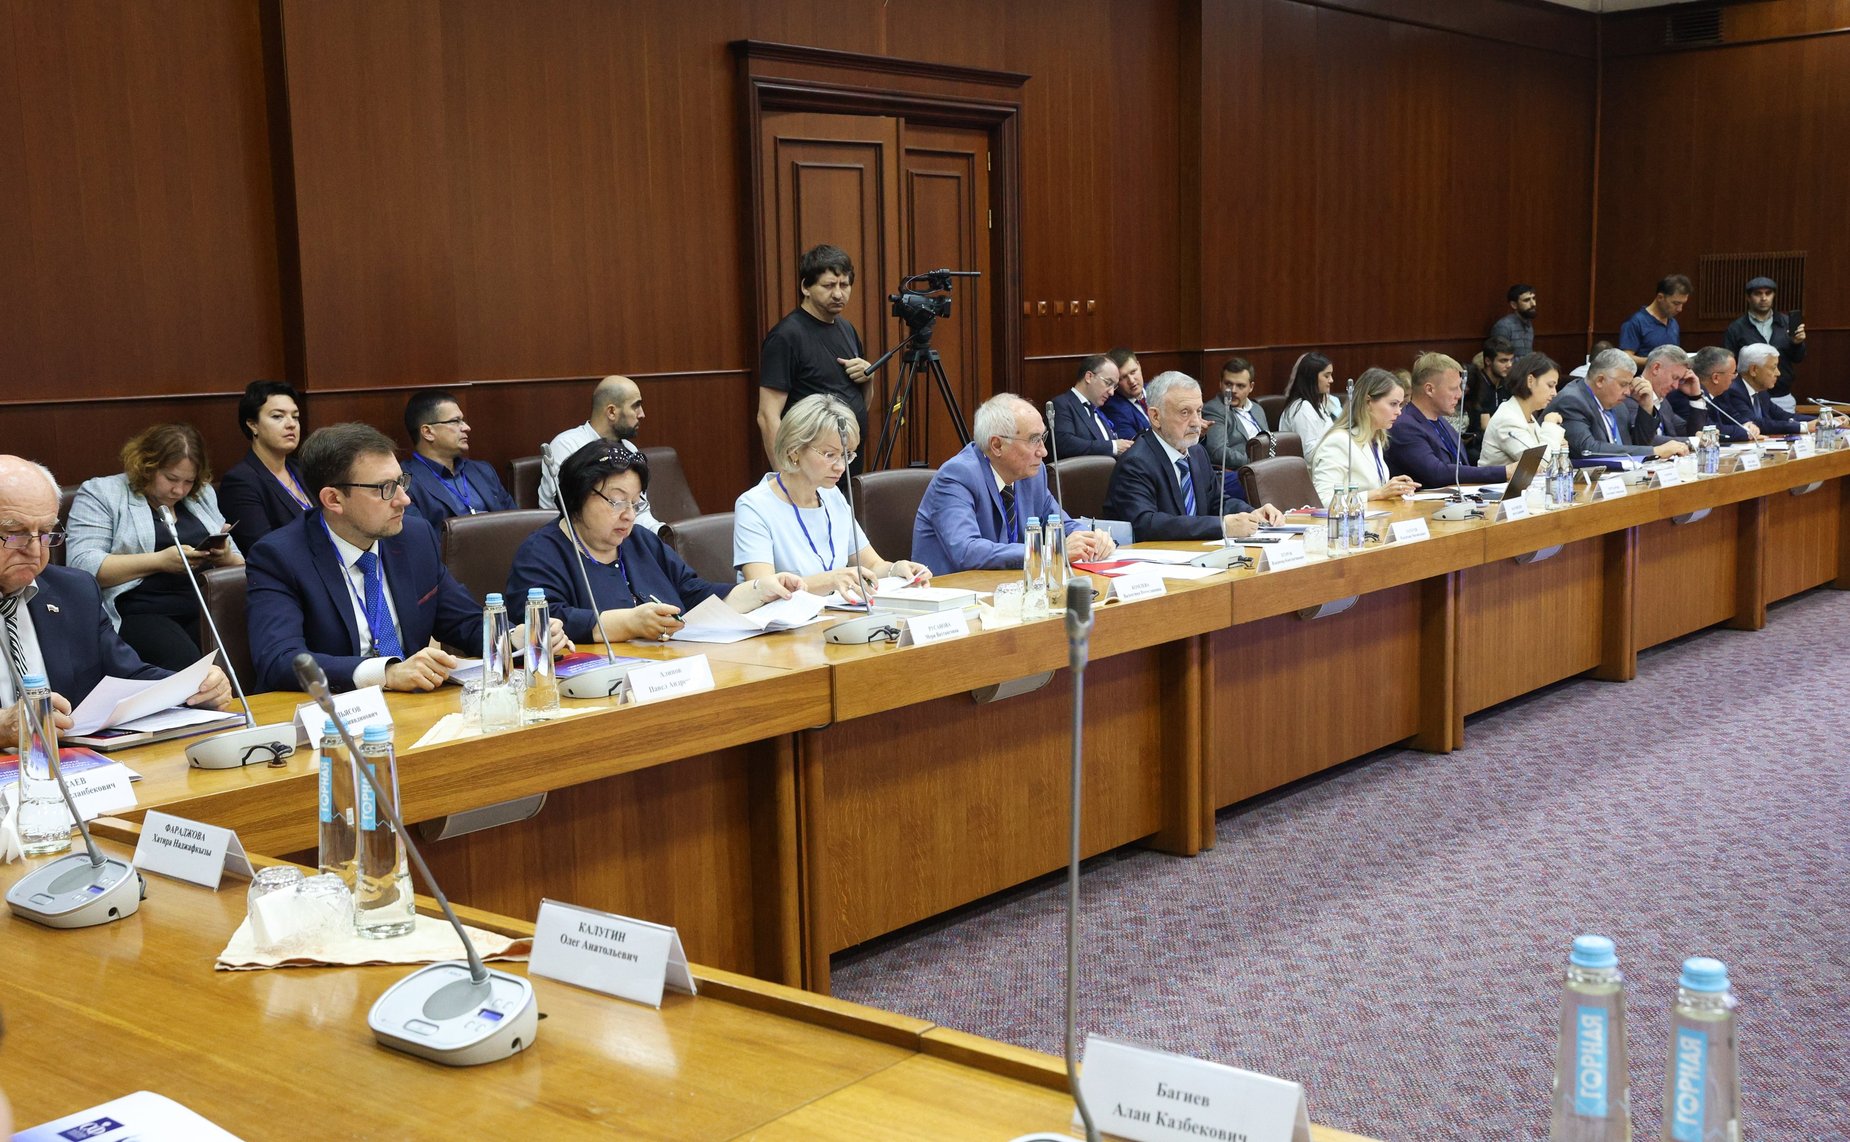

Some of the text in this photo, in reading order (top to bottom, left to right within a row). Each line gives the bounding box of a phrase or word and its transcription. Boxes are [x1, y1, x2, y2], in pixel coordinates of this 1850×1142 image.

[337, 705, 361, 718] ЛЬЯСОВ
[320, 761, 330, 812] ГОРНАЯ
[152, 833, 212, 857] Хатира Наджафкызы
[165, 823, 206, 842] ФАРАДЖОВА
[578, 921, 626, 943] КАЛУГИН
[560, 932, 638, 963] Олег Анатольевич
[1580, 1013, 1604, 1099] ГОРНАЯ
[1155, 1081, 1211, 1108] Багиев
[1676, 1035, 1703, 1126] ГОРНАЯ
[1112, 1101, 1248, 1142] Алан Казбекович
